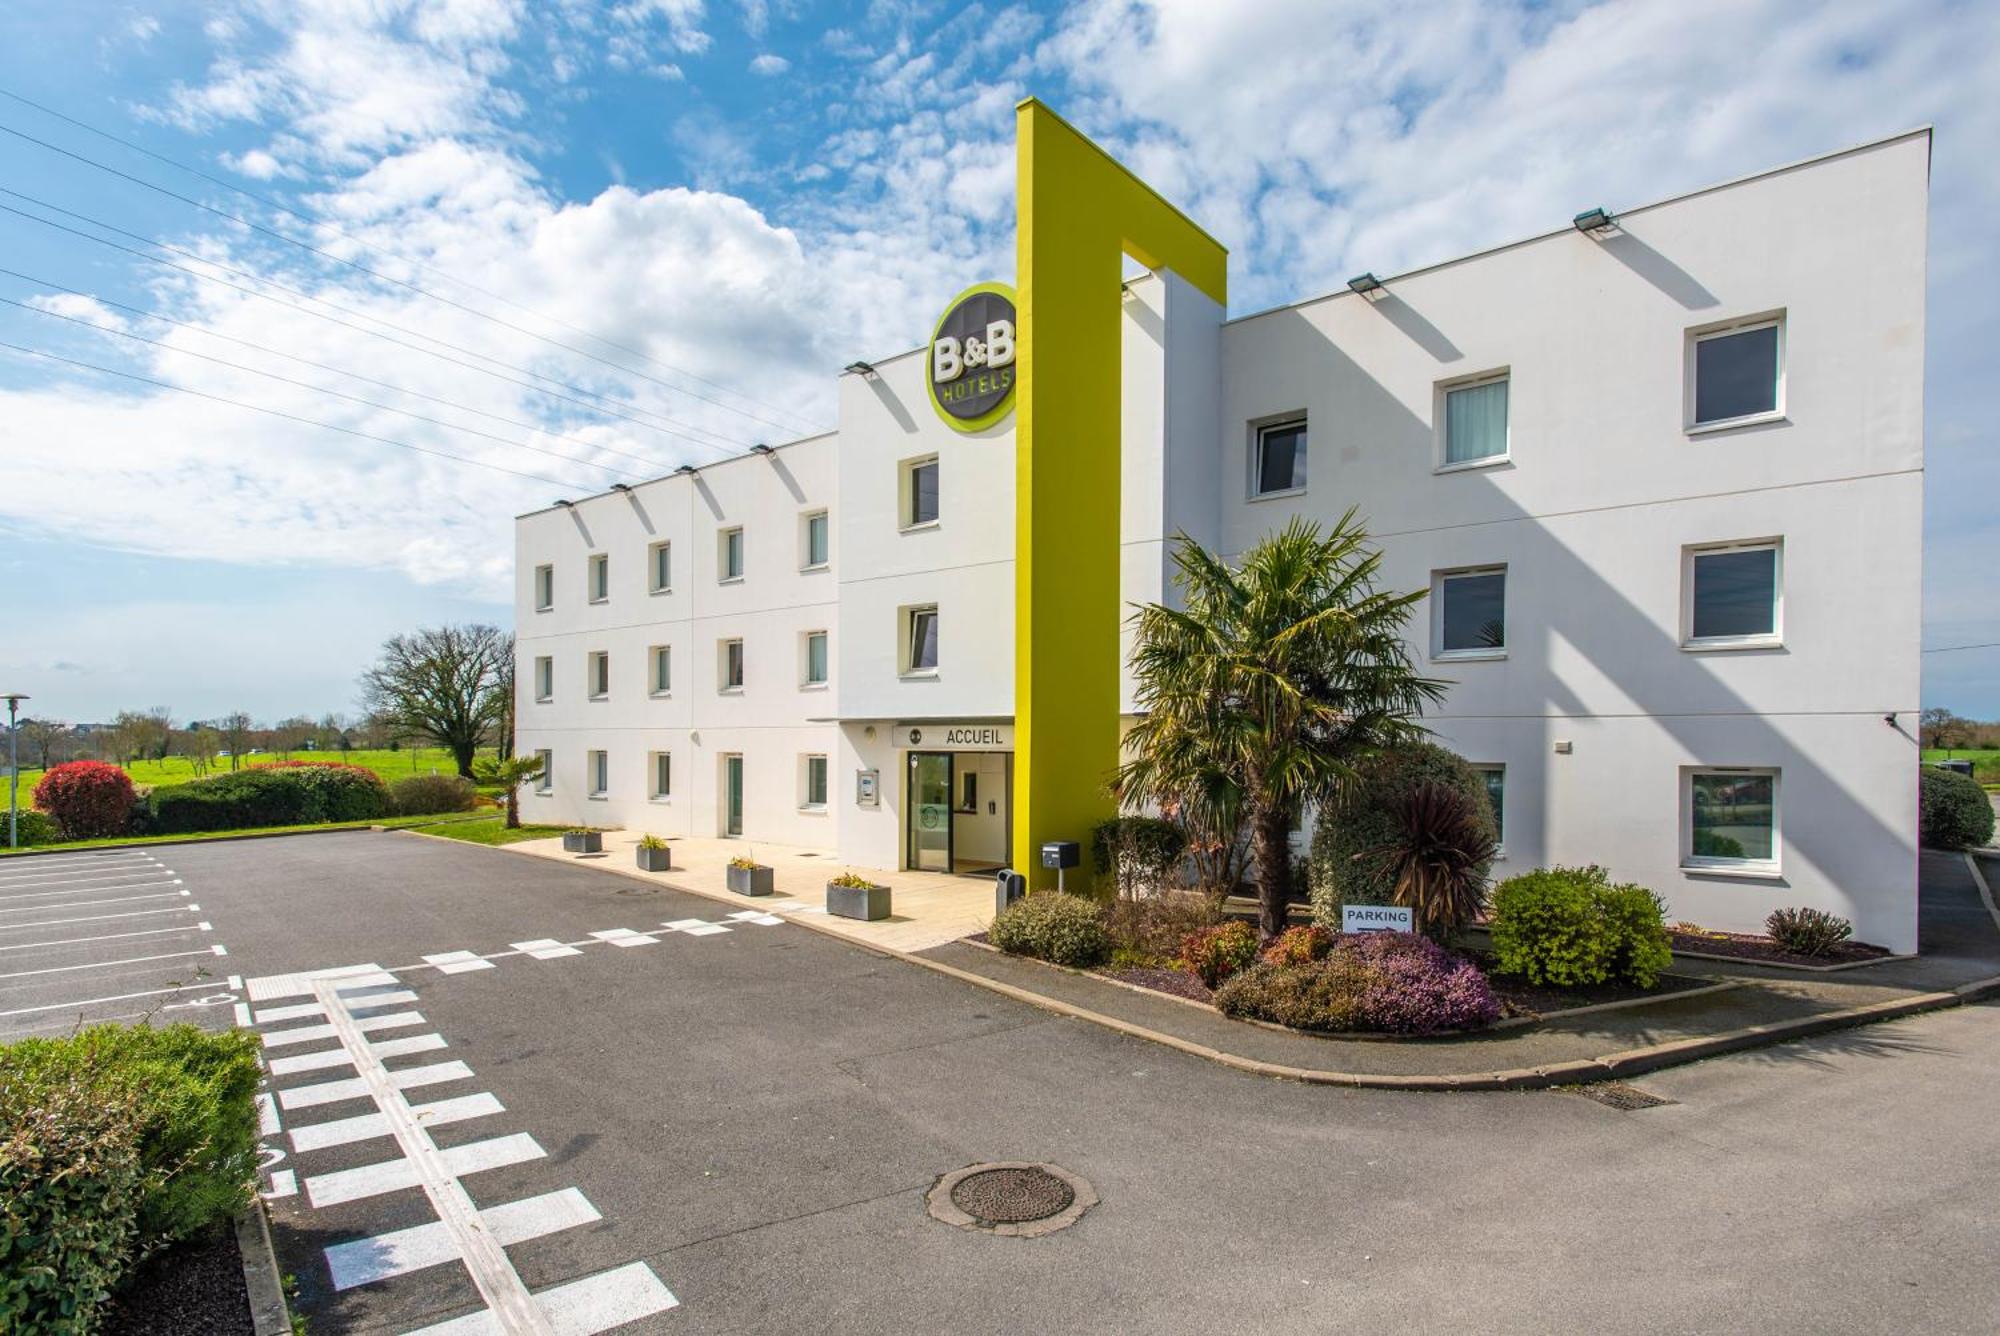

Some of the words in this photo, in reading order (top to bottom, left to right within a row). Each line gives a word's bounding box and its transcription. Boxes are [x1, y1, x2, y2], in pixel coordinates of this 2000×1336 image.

[934, 319, 1016, 383] B&B
[942, 370, 1011, 401] HOTELS
[947, 729, 1003, 744] ACCUEIL
[1347, 910, 1408, 922] PARKING
